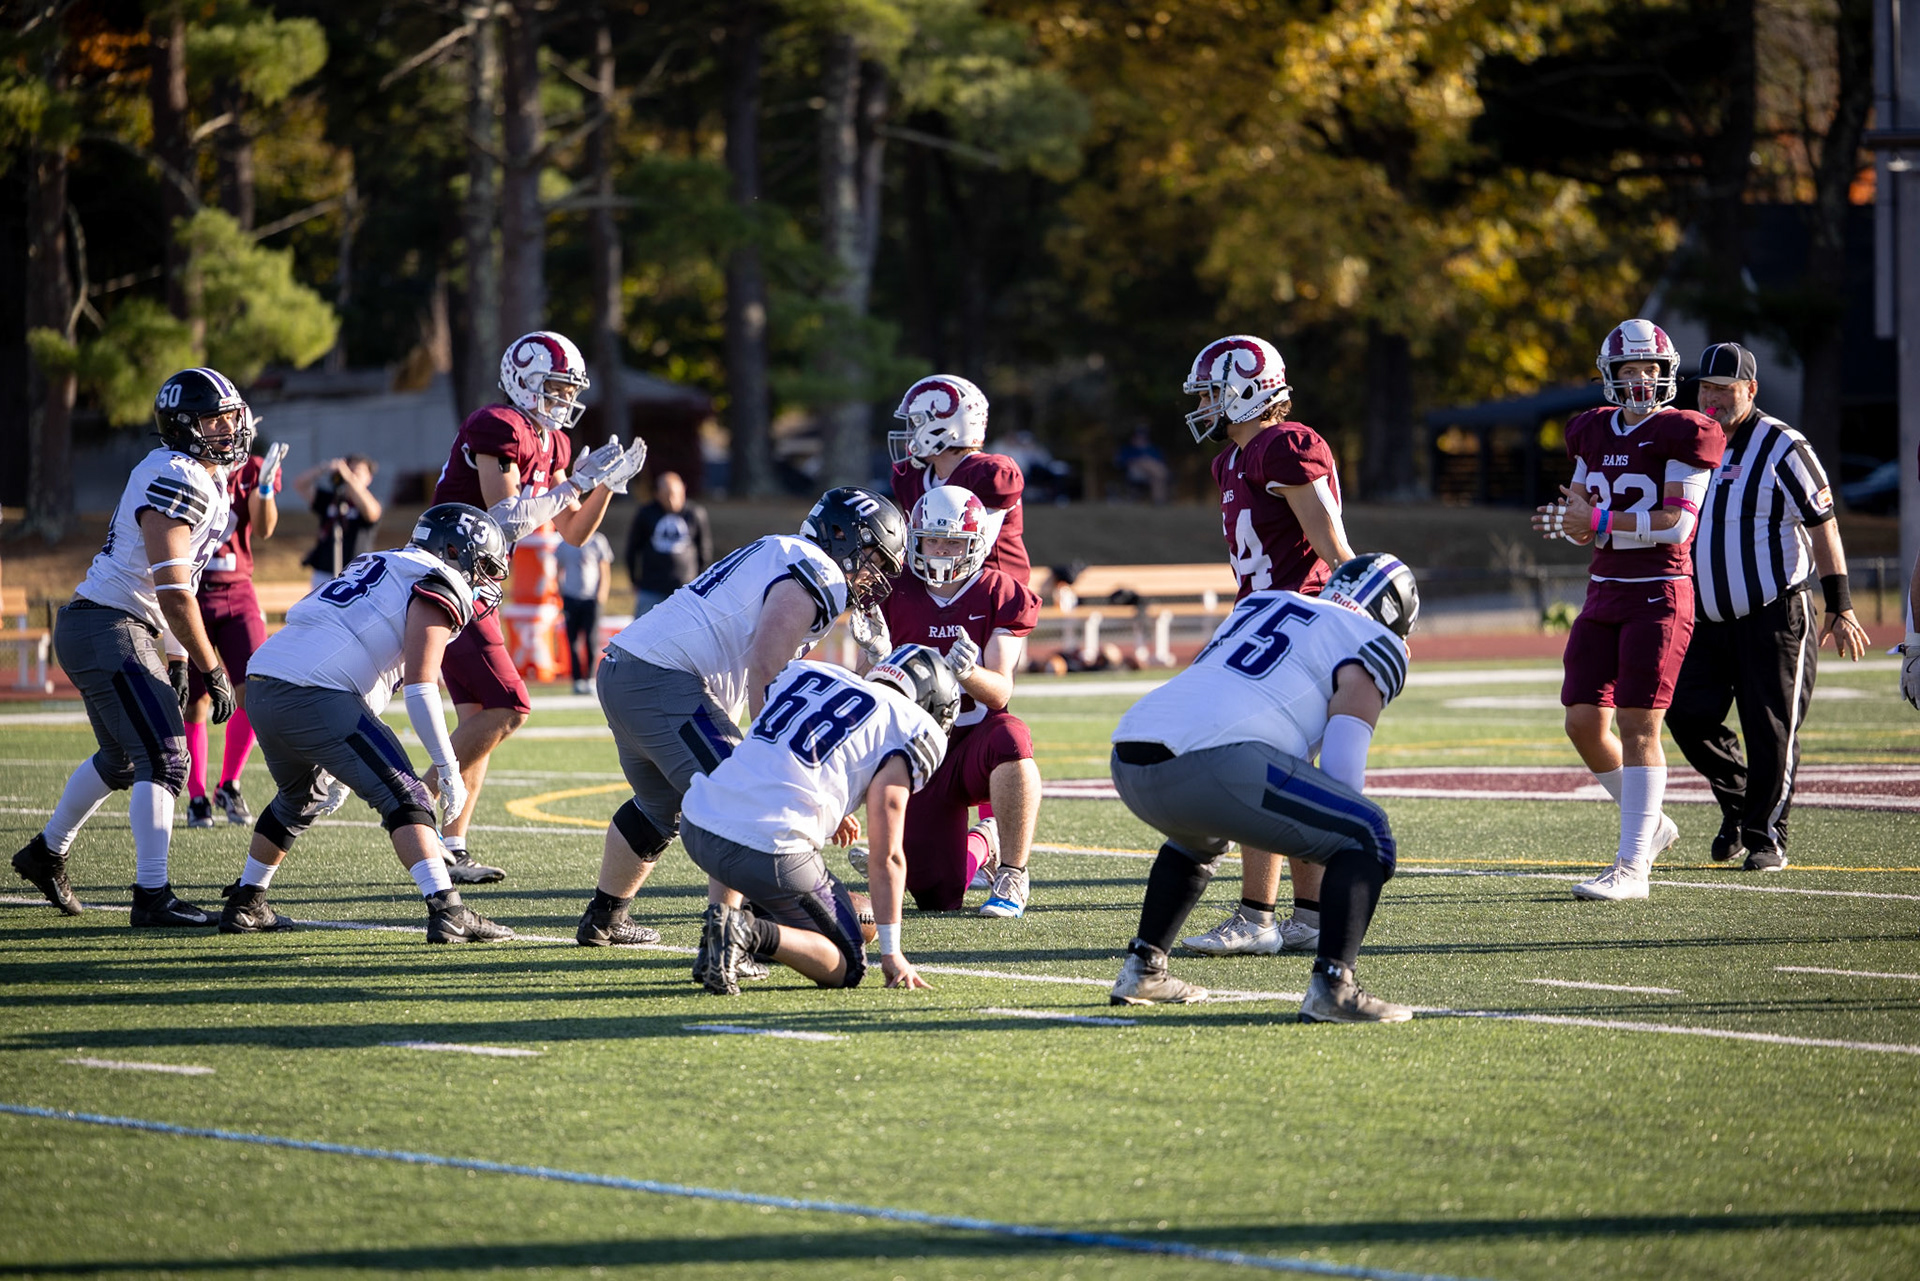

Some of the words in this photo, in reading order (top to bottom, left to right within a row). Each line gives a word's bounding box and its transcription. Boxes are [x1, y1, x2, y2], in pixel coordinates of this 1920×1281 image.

[159, 384, 182, 408] 50
[1602, 454, 1629, 466] RAMS
[844, 490, 880, 517] 70
[457, 513, 490, 544] 53
[928, 625, 962, 638] RAMS
[1194, 597, 1320, 681] 75
[751, 670, 880, 769] 68
